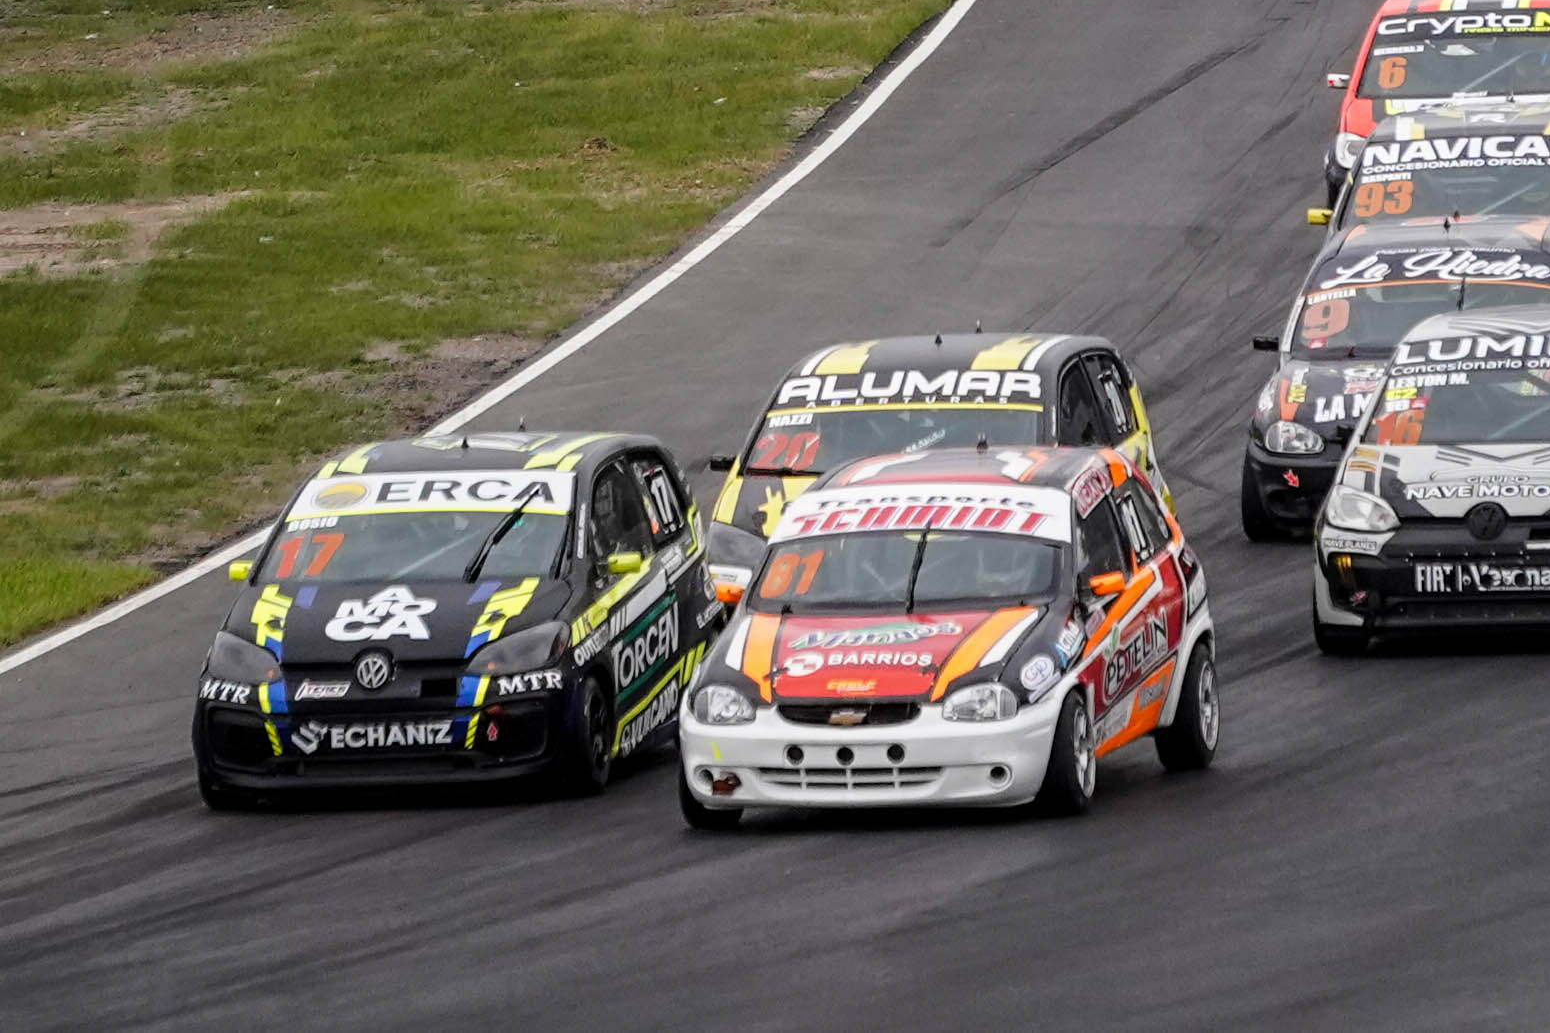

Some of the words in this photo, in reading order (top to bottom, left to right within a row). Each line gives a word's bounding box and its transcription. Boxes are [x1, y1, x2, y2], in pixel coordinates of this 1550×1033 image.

[1378, 57, 1407, 89] 6
[1362, 159, 1485, 175] CONCESIONARIO
[1486, 158, 1546, 167] OFICIAL
[1355, 182, 1413, 217] 93
[1320, 254, 1392, 289] La
[1302, 298, 1350, 340] 9
[1390, 357, 1519, 377] Concesionario
[777, 370, 1042, 405] ALUMAR
[805, 396, 1009, 409] ABERTURAS
[1314, 394, 1346, 423] LA
[768, 413, 814, 428] NAZZI
[1375, 409, 1426, 446] 16
[751, 431, 822, 471] 20
[376, 479, 556, 504] ERCA
[1404, 485, 1474, 501] NAVE
[1466, 475, 1529, 484] GRUPO
[817, 494, 1034, 510] Transporte
[275, 533, 345, 579] 17
[759, 549, 825, 599] 81
[1415, 563, 1454, 593] FIAT
[610, 601, 680, 693] TORCEN
[827, 651, 933, 667] BARRIOS
[200, 679, 251, 705] MTR
[497, 668, 563, 696] MTR
